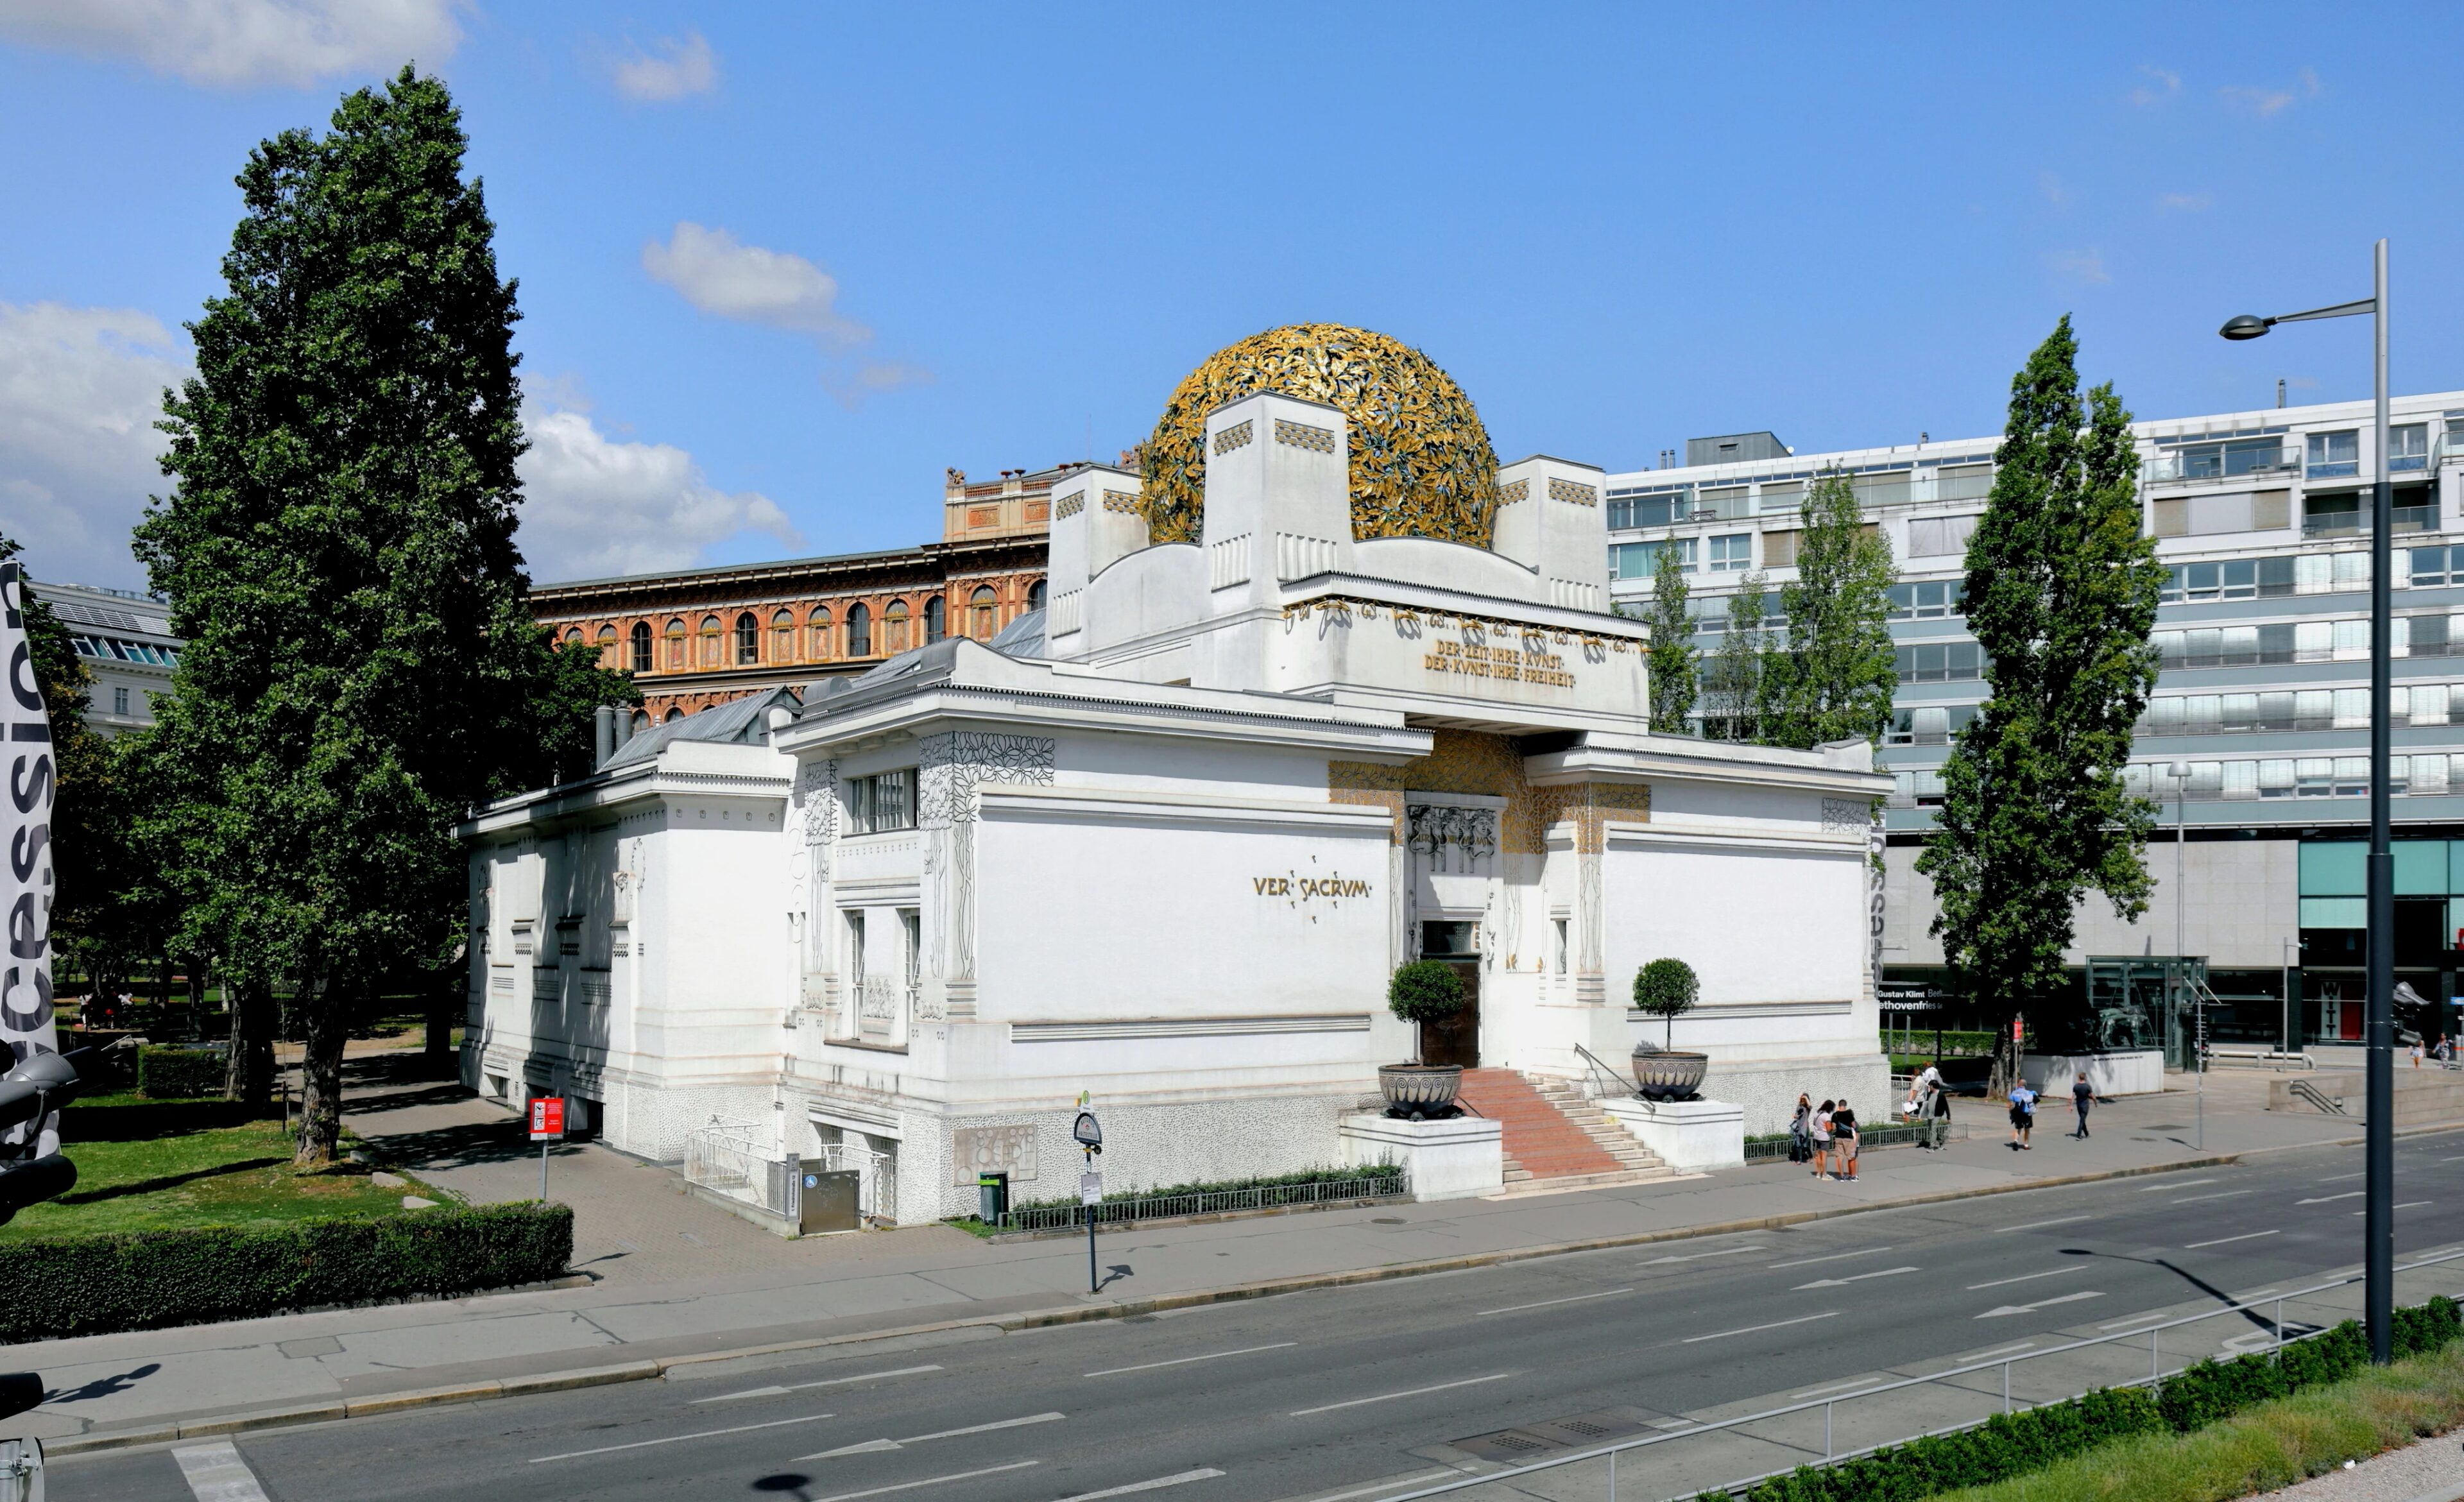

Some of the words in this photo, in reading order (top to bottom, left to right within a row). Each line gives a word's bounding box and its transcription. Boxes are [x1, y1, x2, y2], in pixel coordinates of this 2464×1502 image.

[1436, 639, 1460, 657] DER
[1464, 644, 1489, 661] ZEIT
[1492, 647, 1519, 665] IHRE
[1424, 654, 1448, 672] DER
[1493, 663, 1519, 681] IHRE
[1523, 668, 1574, 688] FREIHEIT
[1253, 878, 1290, 896] VER
[1299, 878, 1369, 901] SACRVM
[1878, 990, 1904, 998] Gustav
[1906, 990, 1925, 998] Klimt
[1879, 1000, 1936, 1010] ethovenfries
[2323, 982, 2340, 1037] WITT
[1079, 1131, 1097, 1139] HALTESTELLE
